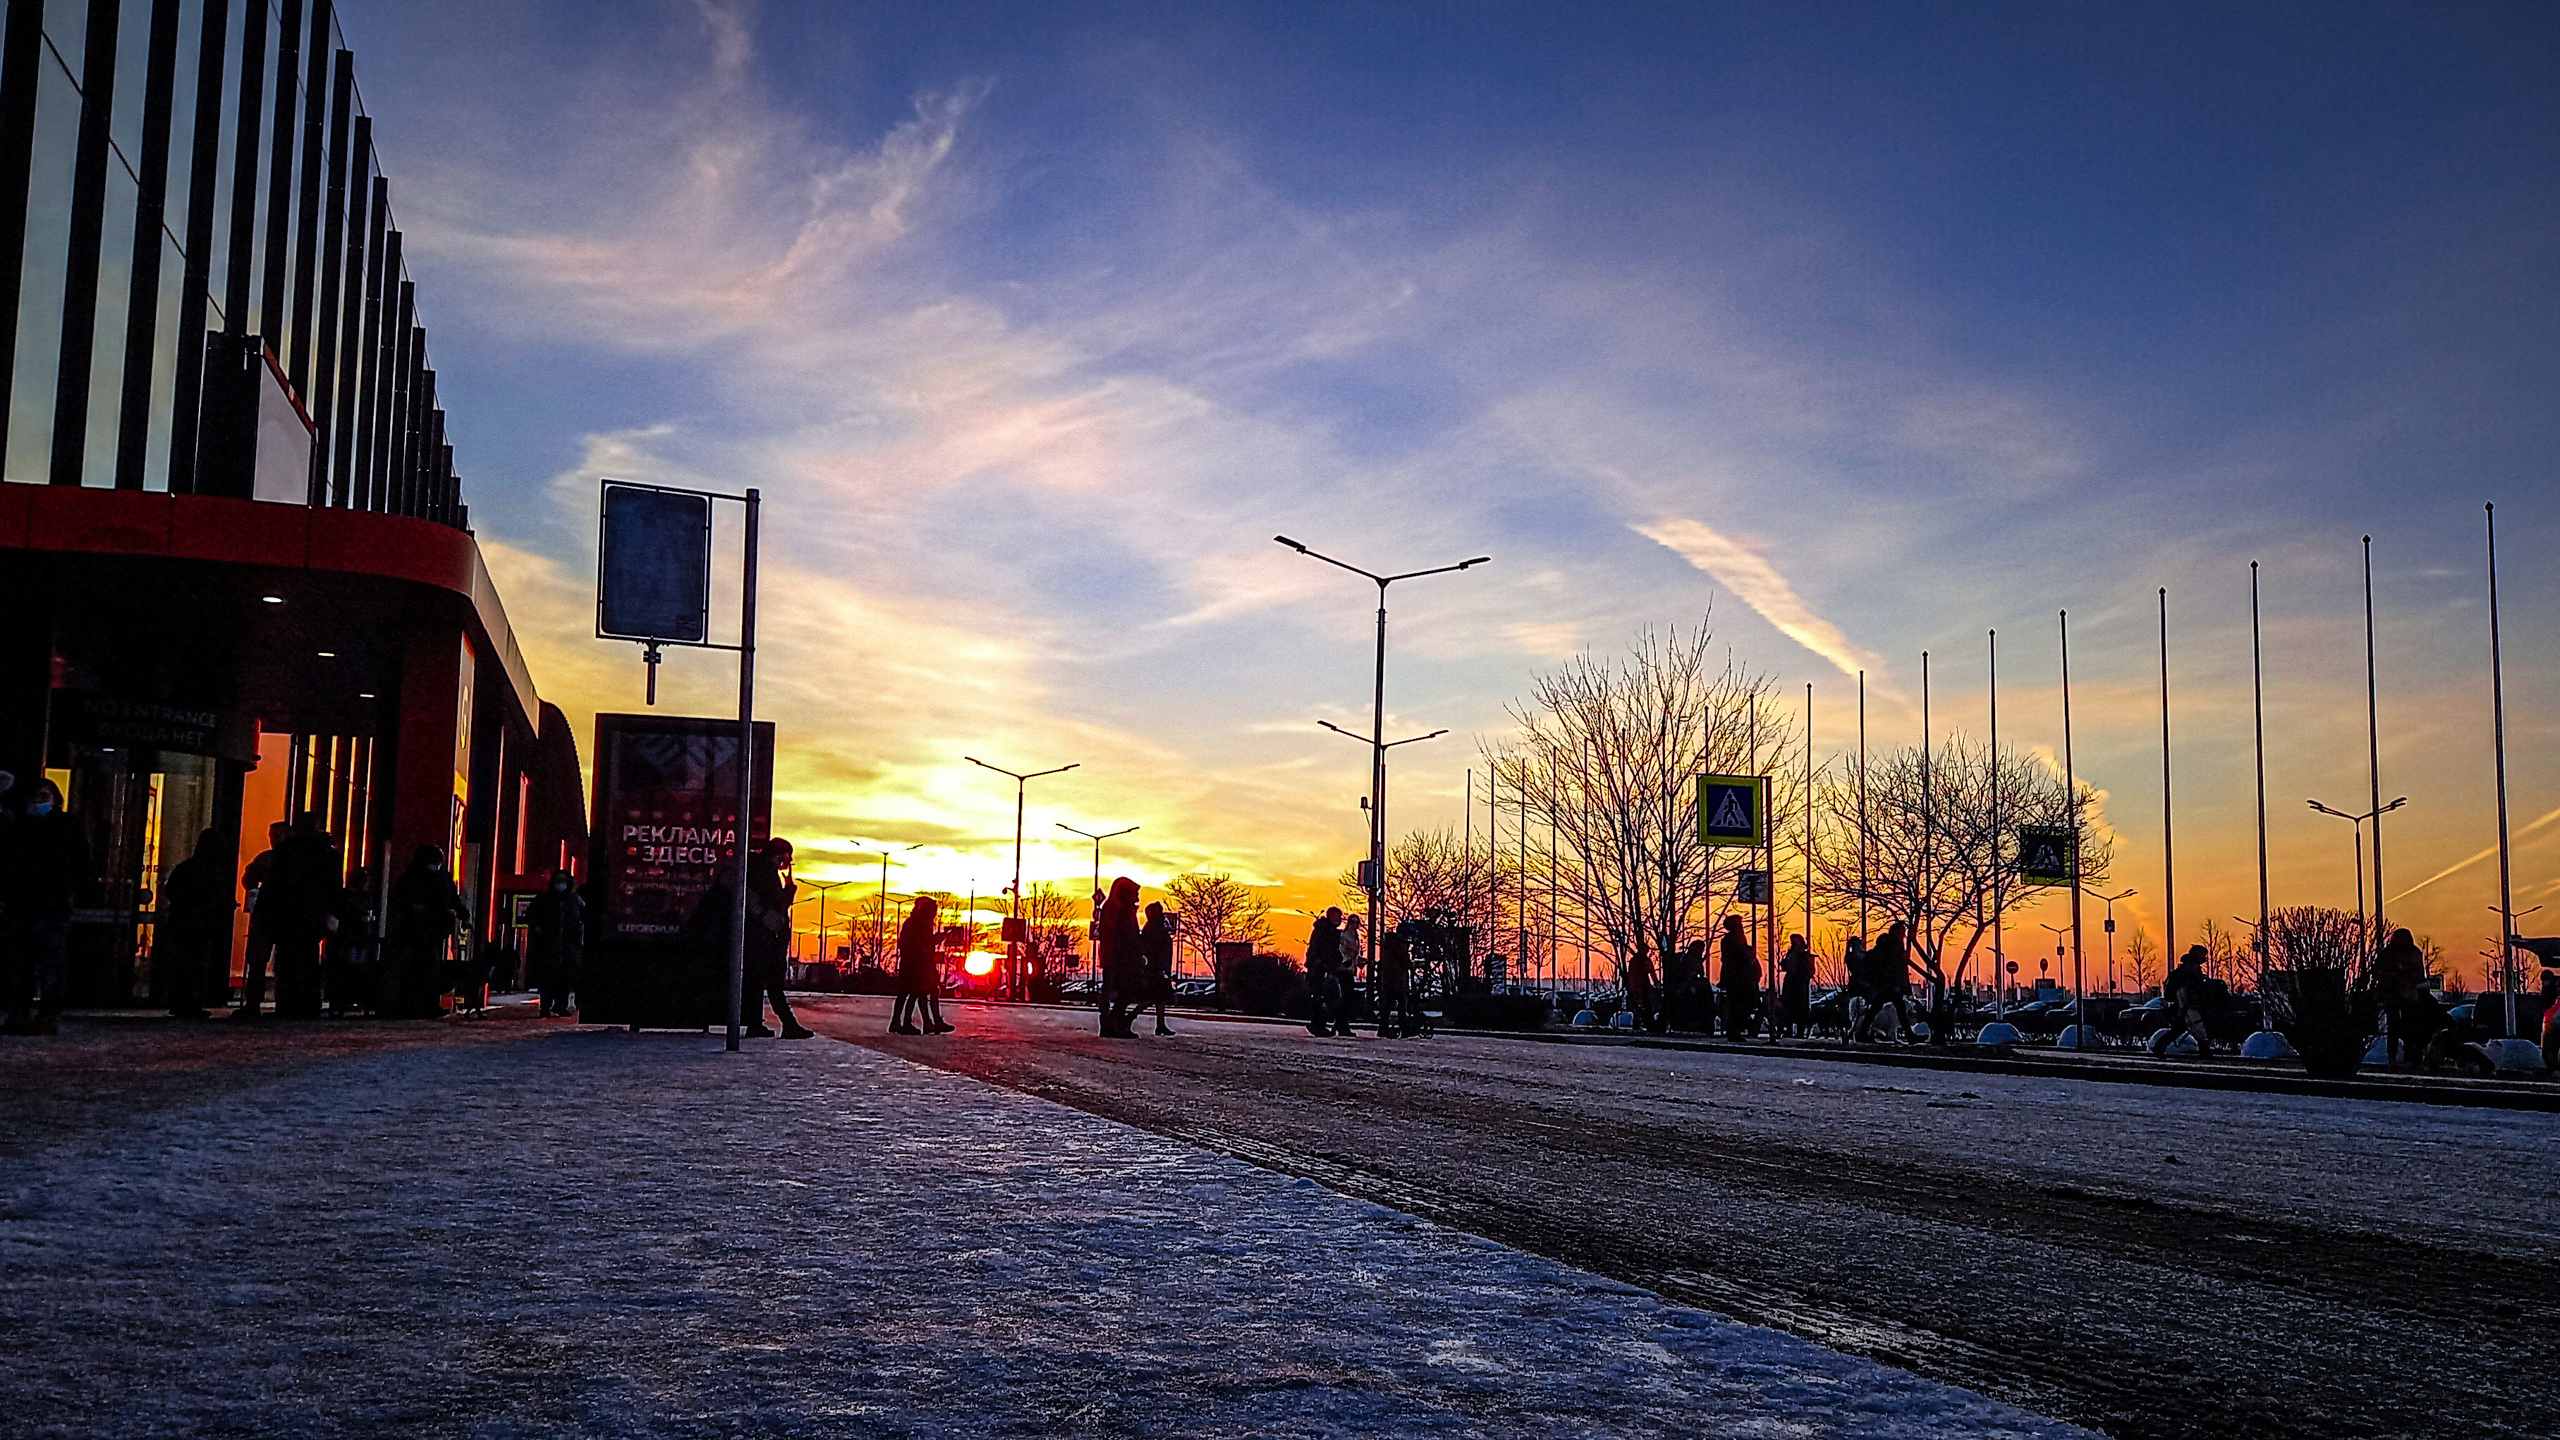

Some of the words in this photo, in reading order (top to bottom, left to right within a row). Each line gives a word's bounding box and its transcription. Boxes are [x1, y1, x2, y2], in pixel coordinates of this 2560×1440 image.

[84, 698, 118, 715] NO
[122, 701, 217, 728] ENTRANCE
[172, 729, 206, 748] НЕТ
[622, 823, 736, 846] РЕКЛАМА
[641, 845, 718, 866] ЗДЕСЬ
